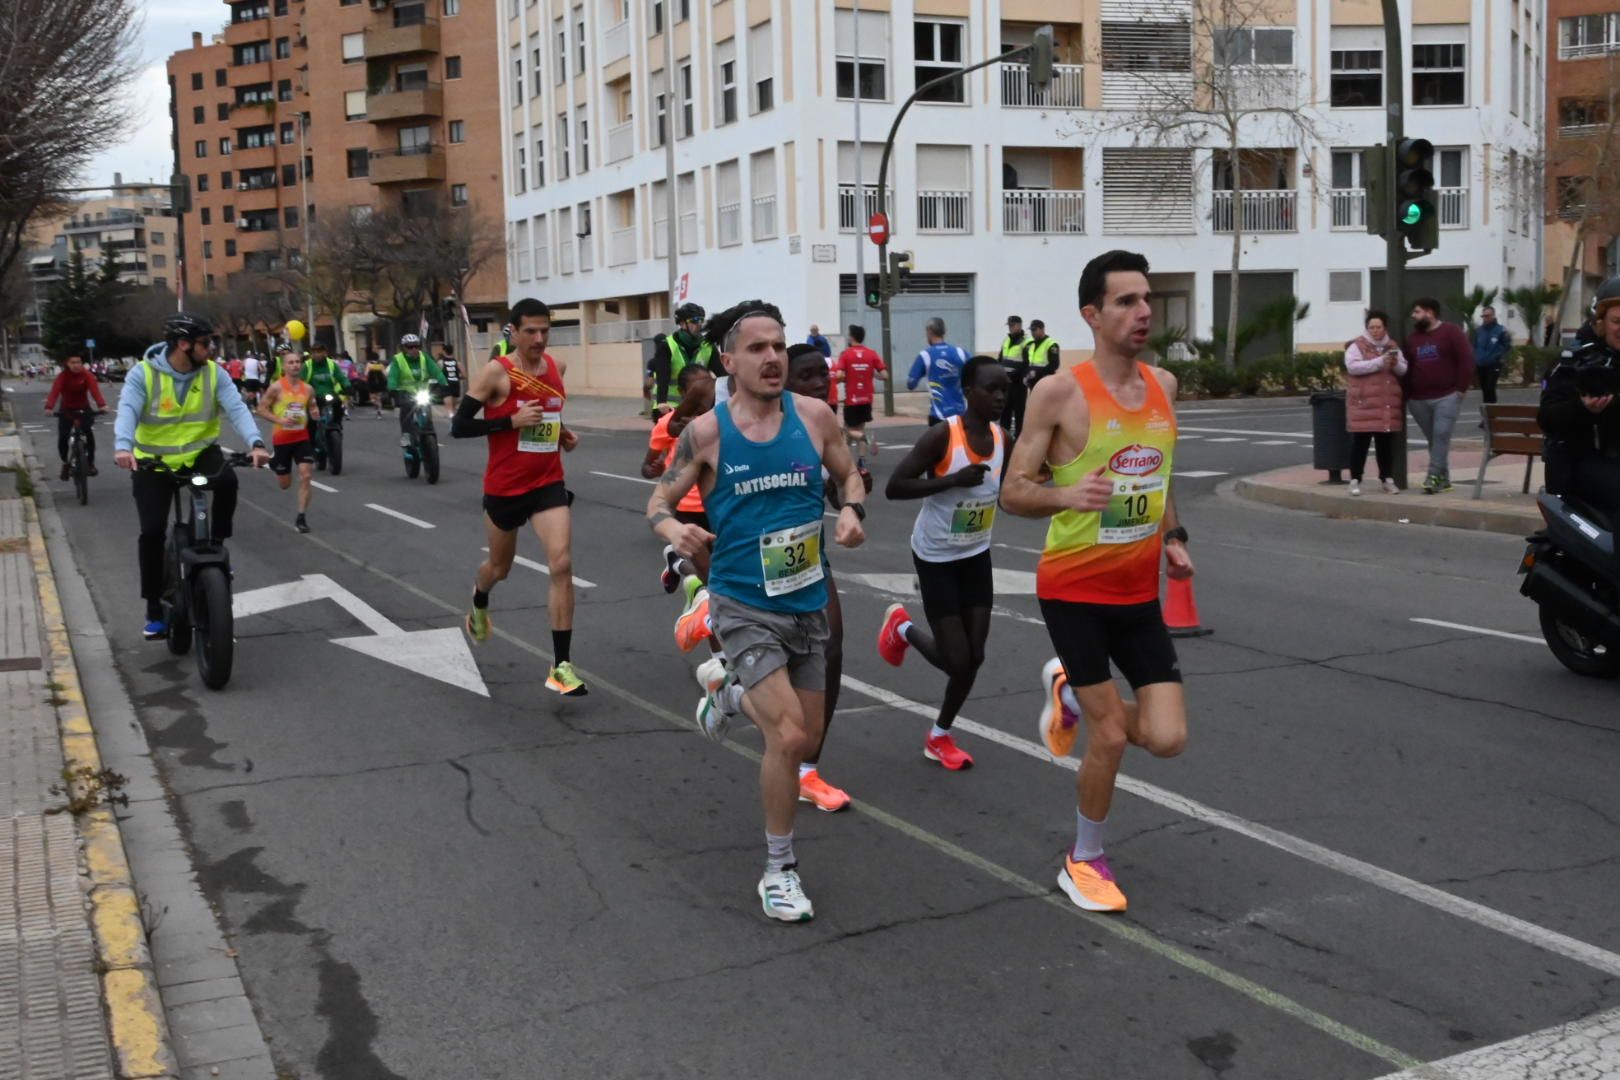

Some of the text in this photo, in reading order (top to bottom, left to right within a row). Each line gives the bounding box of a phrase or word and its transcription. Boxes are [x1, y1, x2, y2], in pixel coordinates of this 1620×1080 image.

[1113, 454, 1160, 470] Serrano
[734, 472, 807, 495] ANTISOCIAL
[967, 508, 985, 527] 21
[1124, 494, 1148, 518] 10
[784, 542, 806, 567] 32
